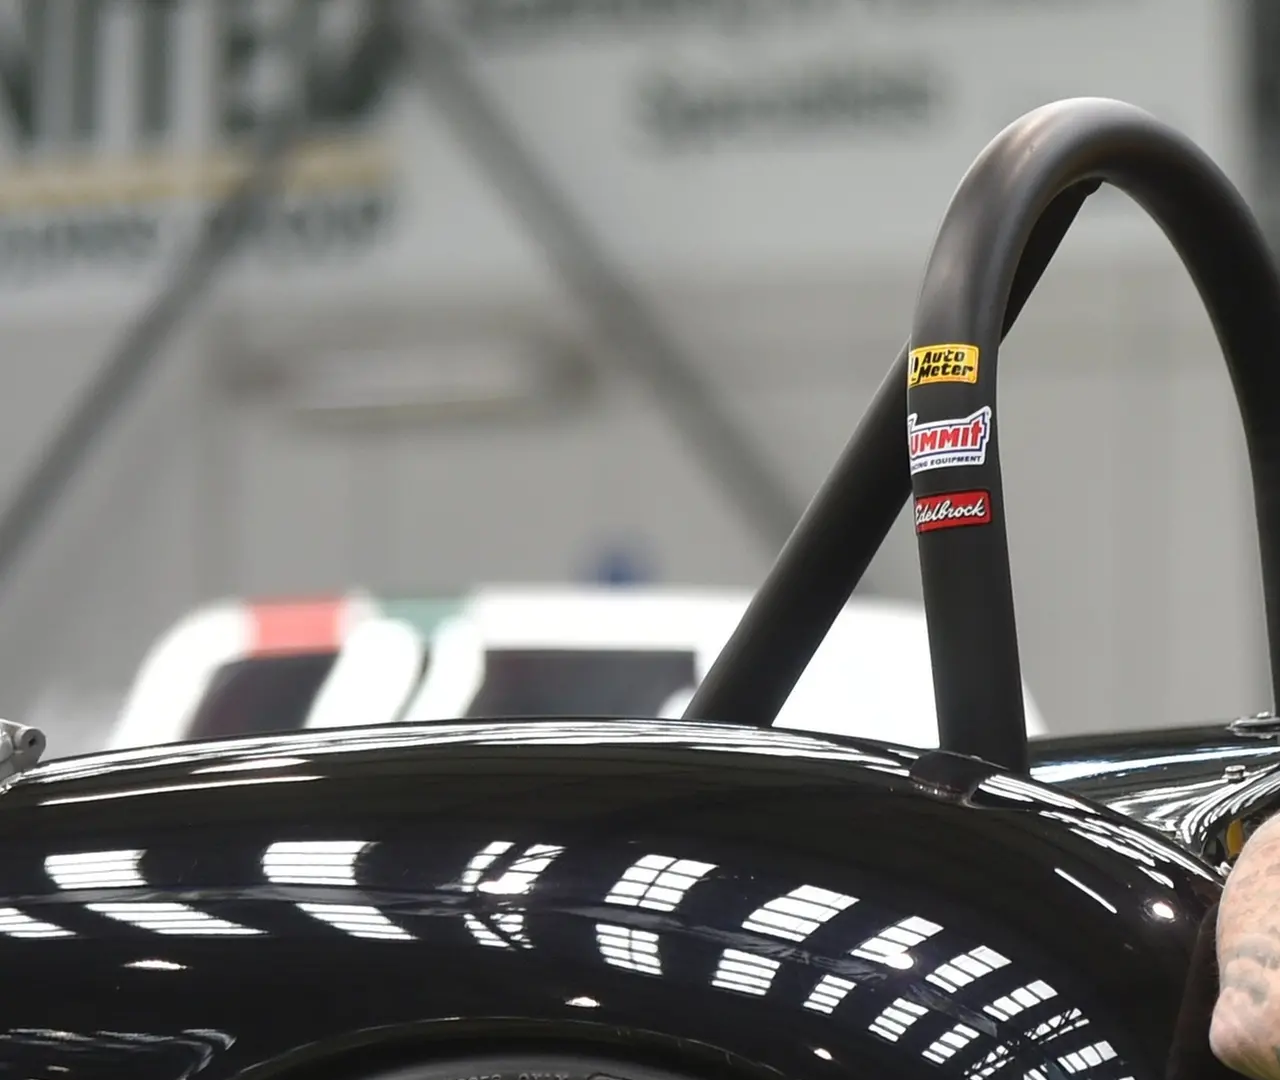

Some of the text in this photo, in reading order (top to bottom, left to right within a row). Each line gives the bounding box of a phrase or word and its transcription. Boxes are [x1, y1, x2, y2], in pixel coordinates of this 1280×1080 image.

[922, 350, 965, 364] Auto
[917, 363, 974, 383] Meter
[916, 499, 986, 525] Edelbrock
